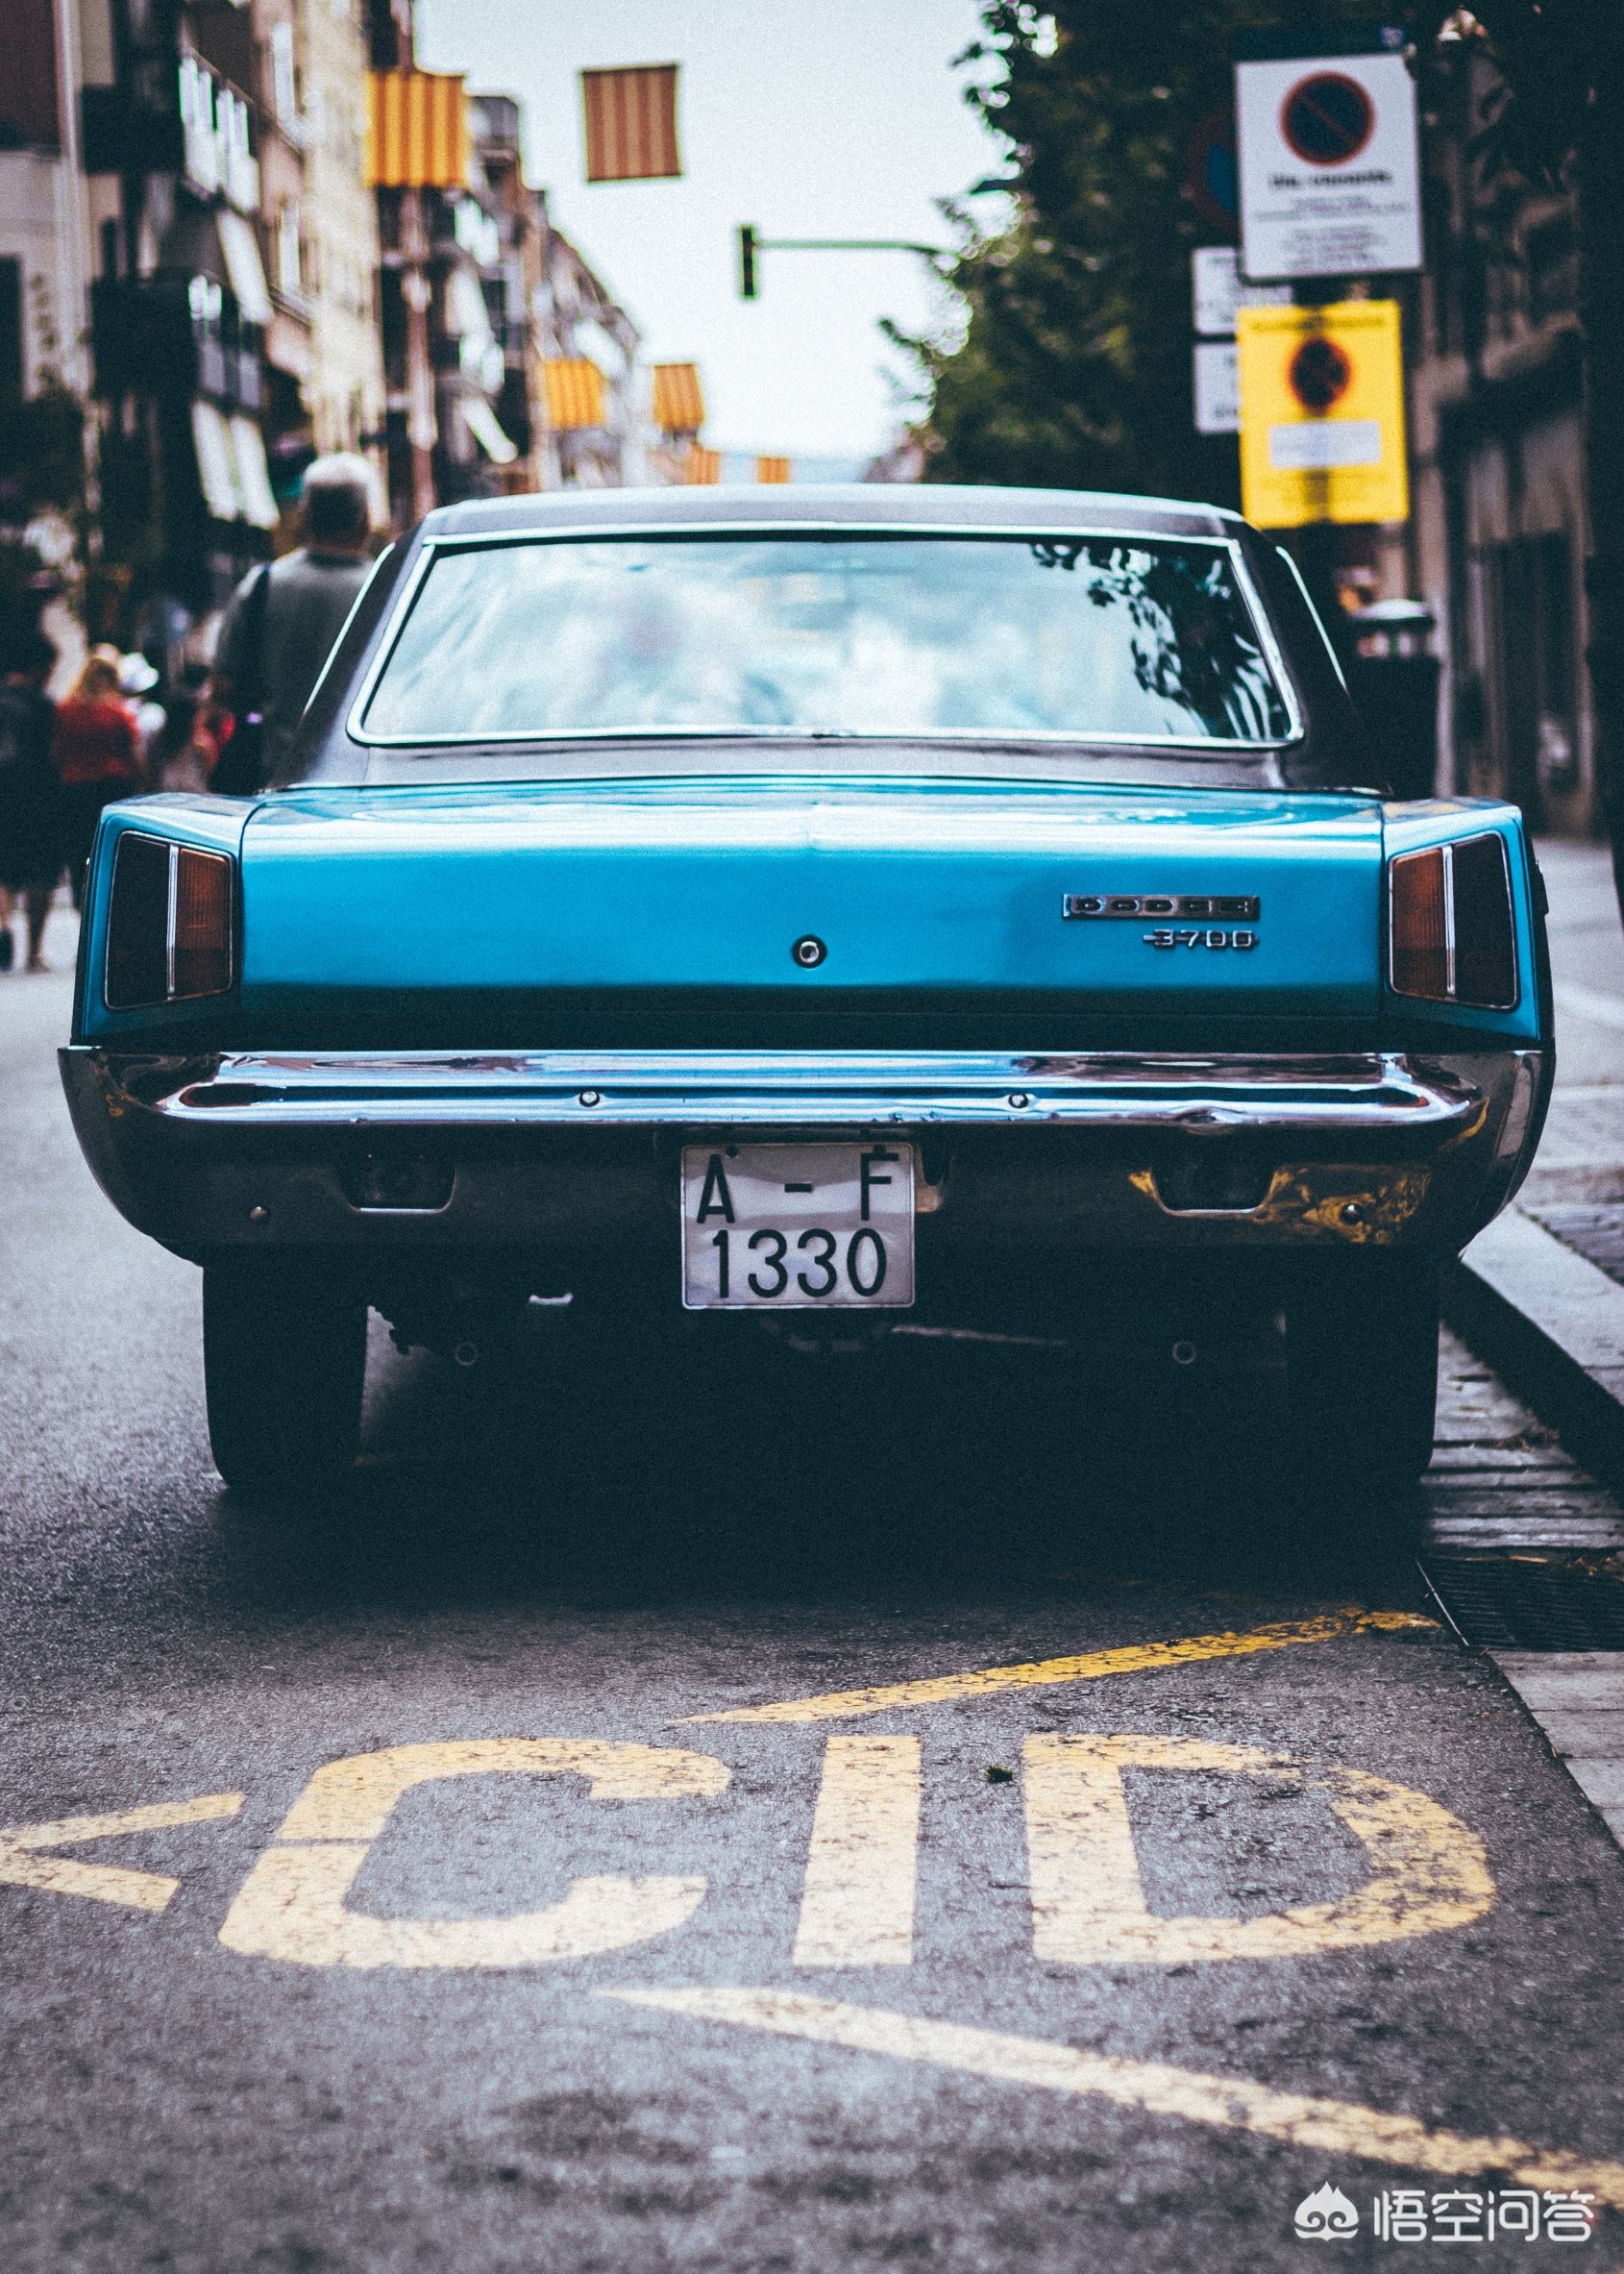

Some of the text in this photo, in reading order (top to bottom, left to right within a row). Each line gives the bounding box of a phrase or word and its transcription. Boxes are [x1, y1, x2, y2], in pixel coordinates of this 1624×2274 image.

[1067, 896, 1254, 916] DODGE
[1153, 928, 1253, 948] 3700
[712, 1227, 887, 1298] 1330
